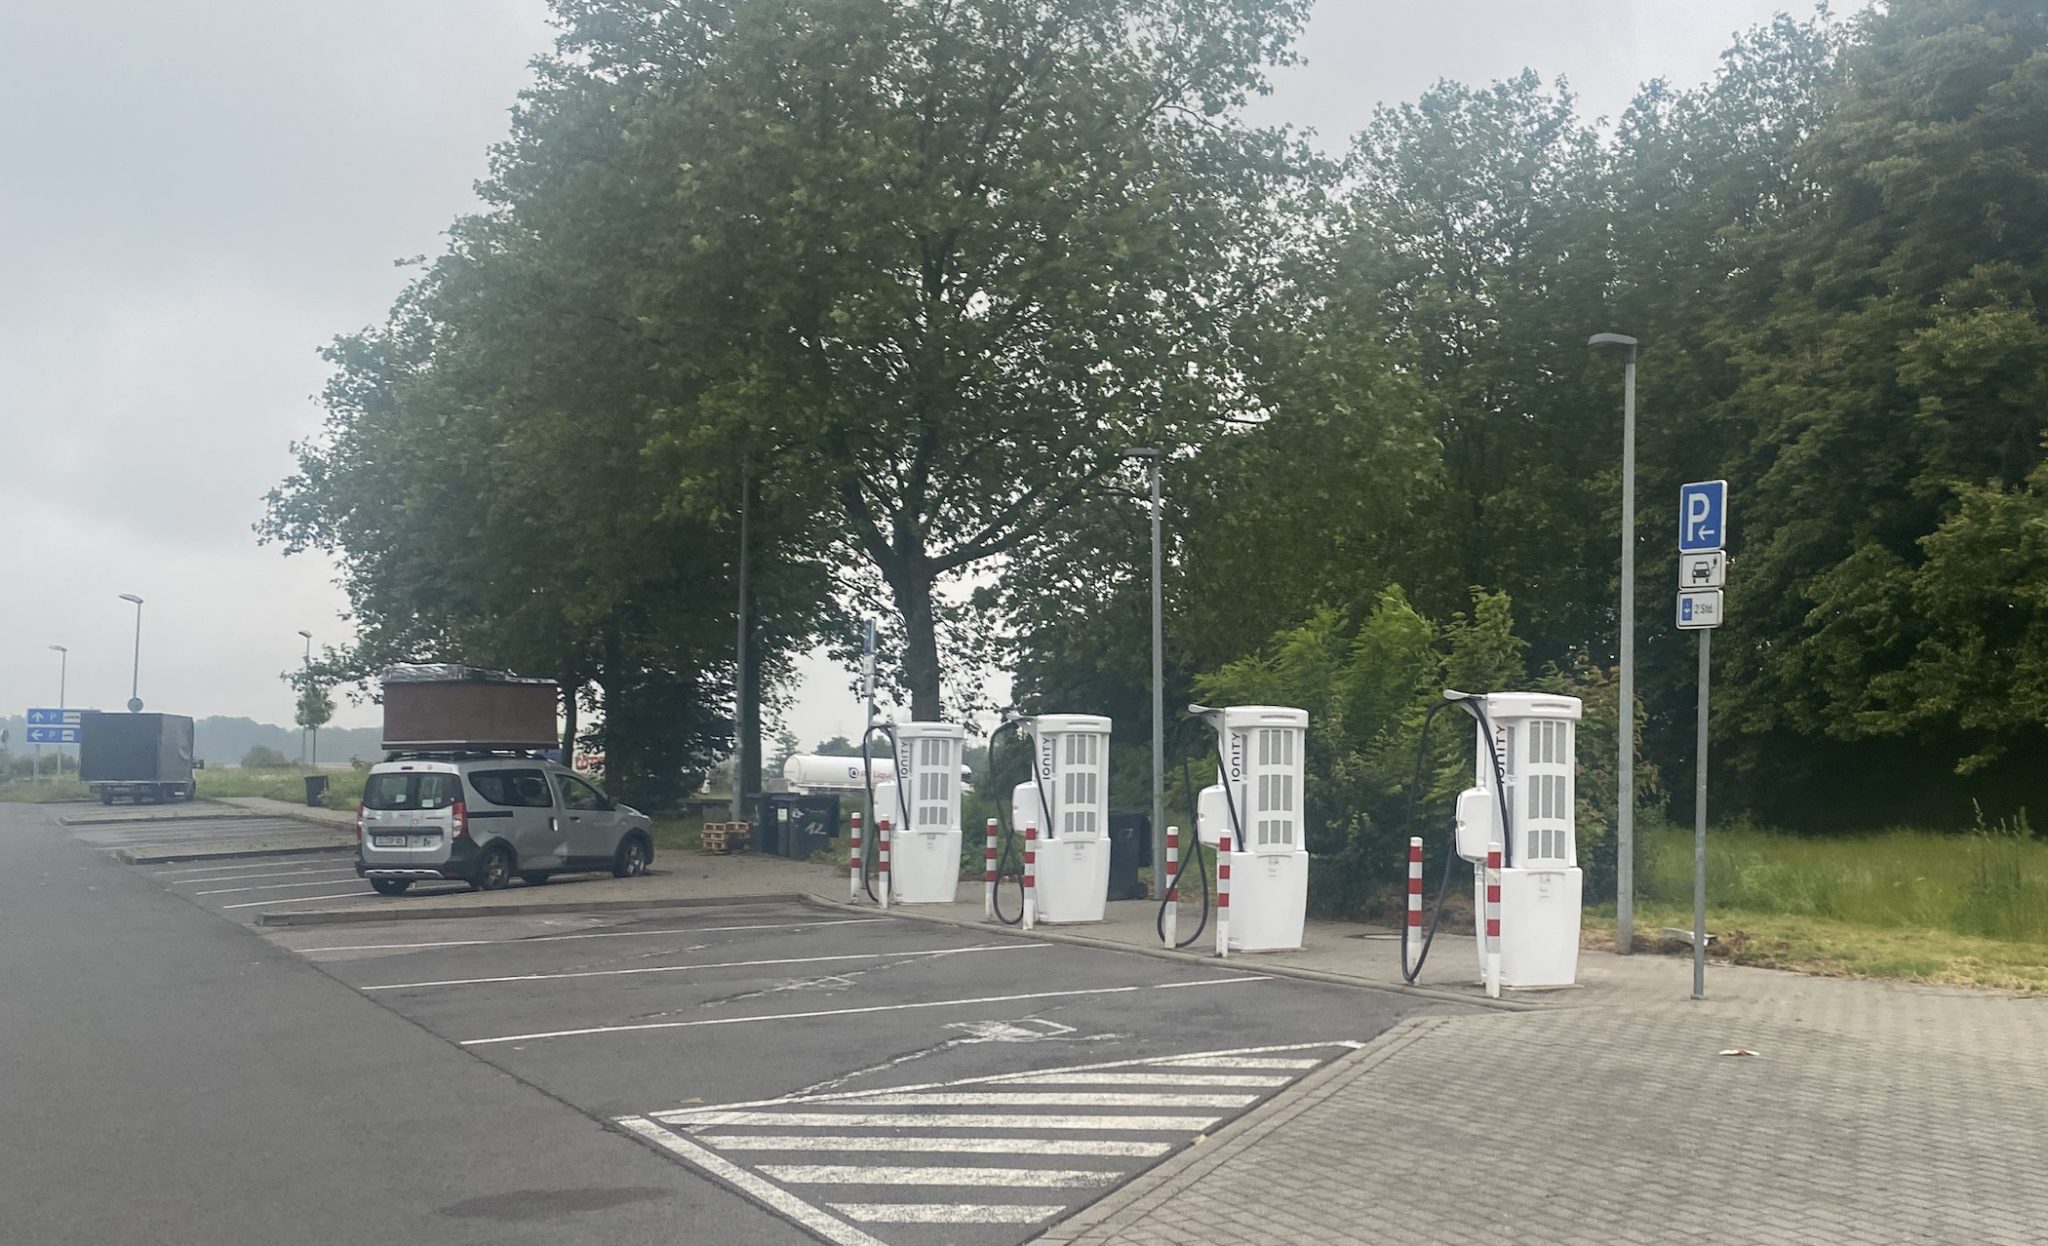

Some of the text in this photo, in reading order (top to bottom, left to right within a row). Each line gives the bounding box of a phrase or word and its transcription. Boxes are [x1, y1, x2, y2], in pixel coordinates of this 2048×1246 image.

[1687, 492, 1710, 542] P
[49, 730, 56, 739] P
[50, 712, 57, 721] P
[900, 741, 908, 779] IONITY
[1042, 737, 1051, 780] IONITY
[1231, 732, 1240, 782] IONITY
